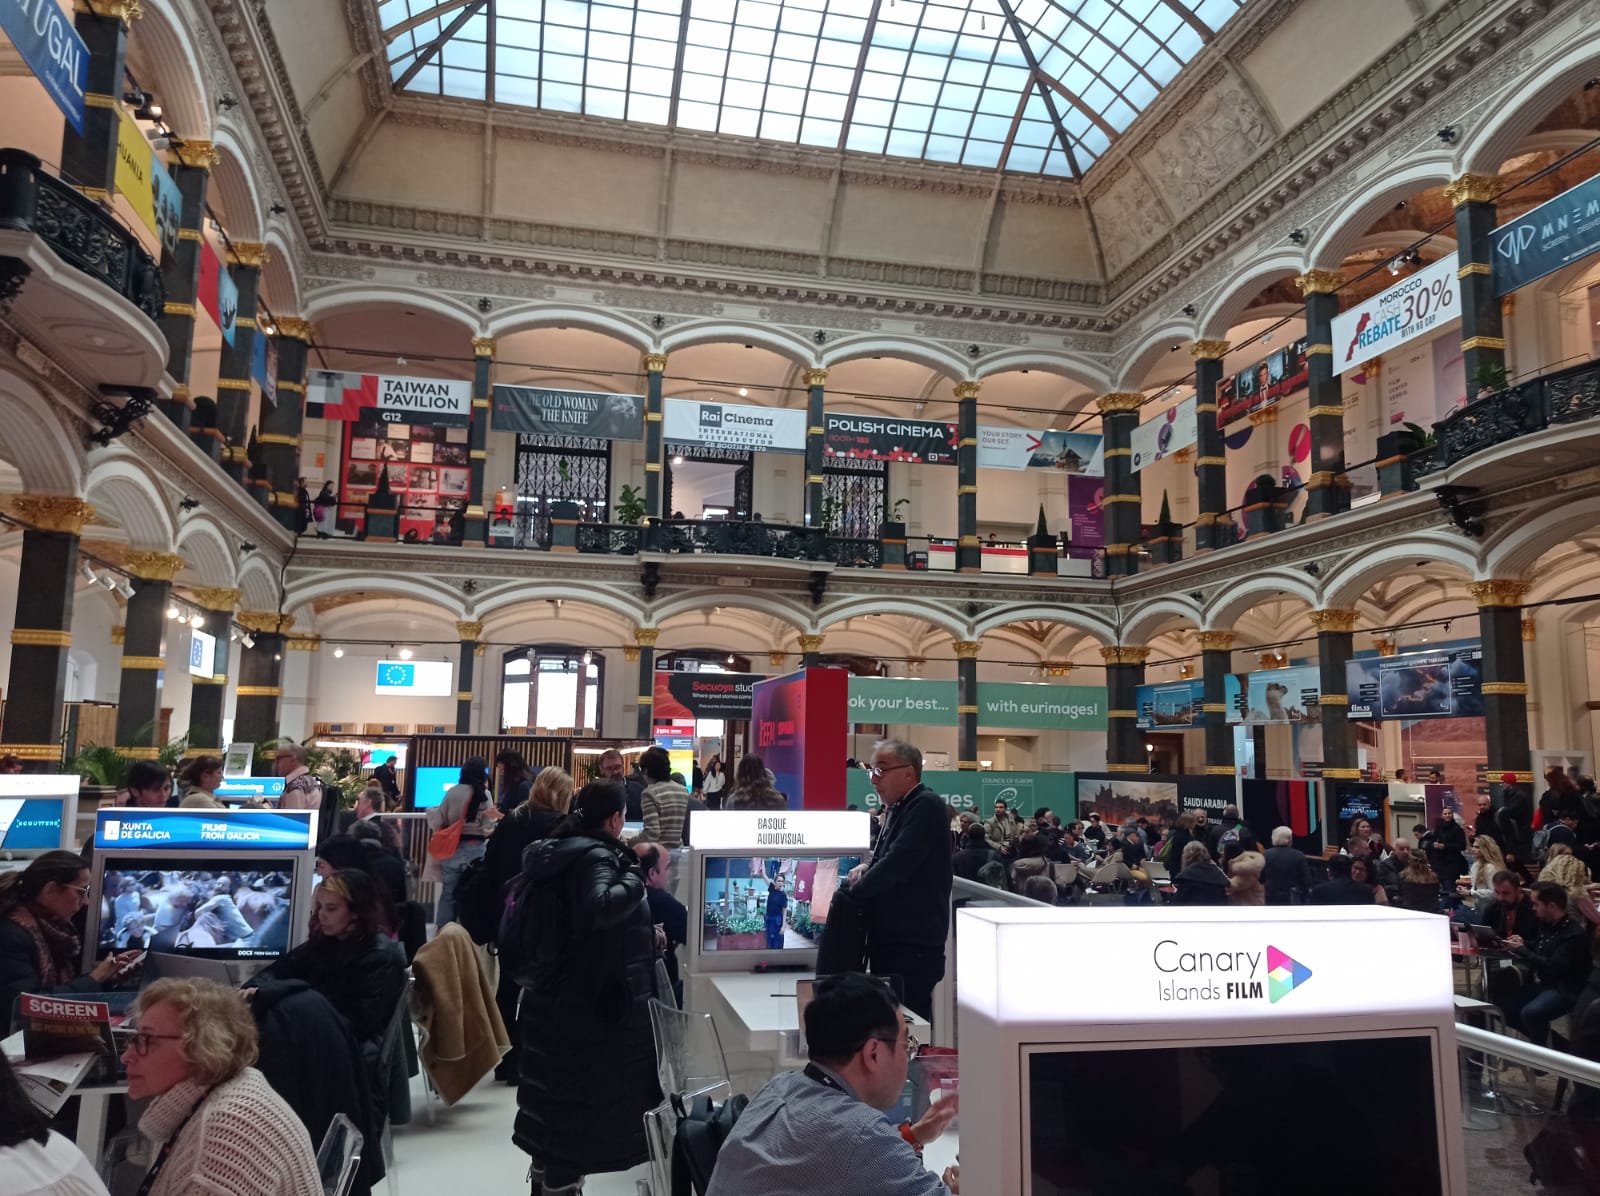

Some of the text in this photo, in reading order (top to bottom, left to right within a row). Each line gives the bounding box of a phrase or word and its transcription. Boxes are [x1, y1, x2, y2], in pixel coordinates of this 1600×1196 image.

[1380, 278, 1422, 307] MOROCCO
[1359, 273, 1453, 349] REBATE 30%
[1374, 302, 1400, 325] CASH
[1401, 324, 1415, 338] WITH
[384, 380, 449, 396] TAIWAN
[384, 393, 459, 410] PAVILION
[542, 393, 561, 408] OLD
[563, 396, 598, 411] WOMAN
[382, 412, 402, 422] G12
[542, 409, 589, 425] THE KNIFE
[701, 411, 774, 426] Rai Cinema
[699, 428, 774, 440] INTERNATIONAL
[828, 419, 944, 438] POLISH CINEMA
[698, 434, 773, 445] DISTRIBUTION
[693, 681, 734, 692] Secuoya
[869, 699, 902, 711] your
[987, 700, 1098, 720] with eurimages!
[1184, 797, 1228, 809] SAUDI ARABIA
[122, 823, 153, 831] XUNTA
[202, 823, 227, 831] FILMS
[121, 831, 133, 839] DE
[201, 832, 260, 840] FROM GALICIA
[1154, 940, 1261, 979] Canary
[1159, 979, 1263, 1001] Islands FILM
[29, 1000, 98, 1017] SCREEN
